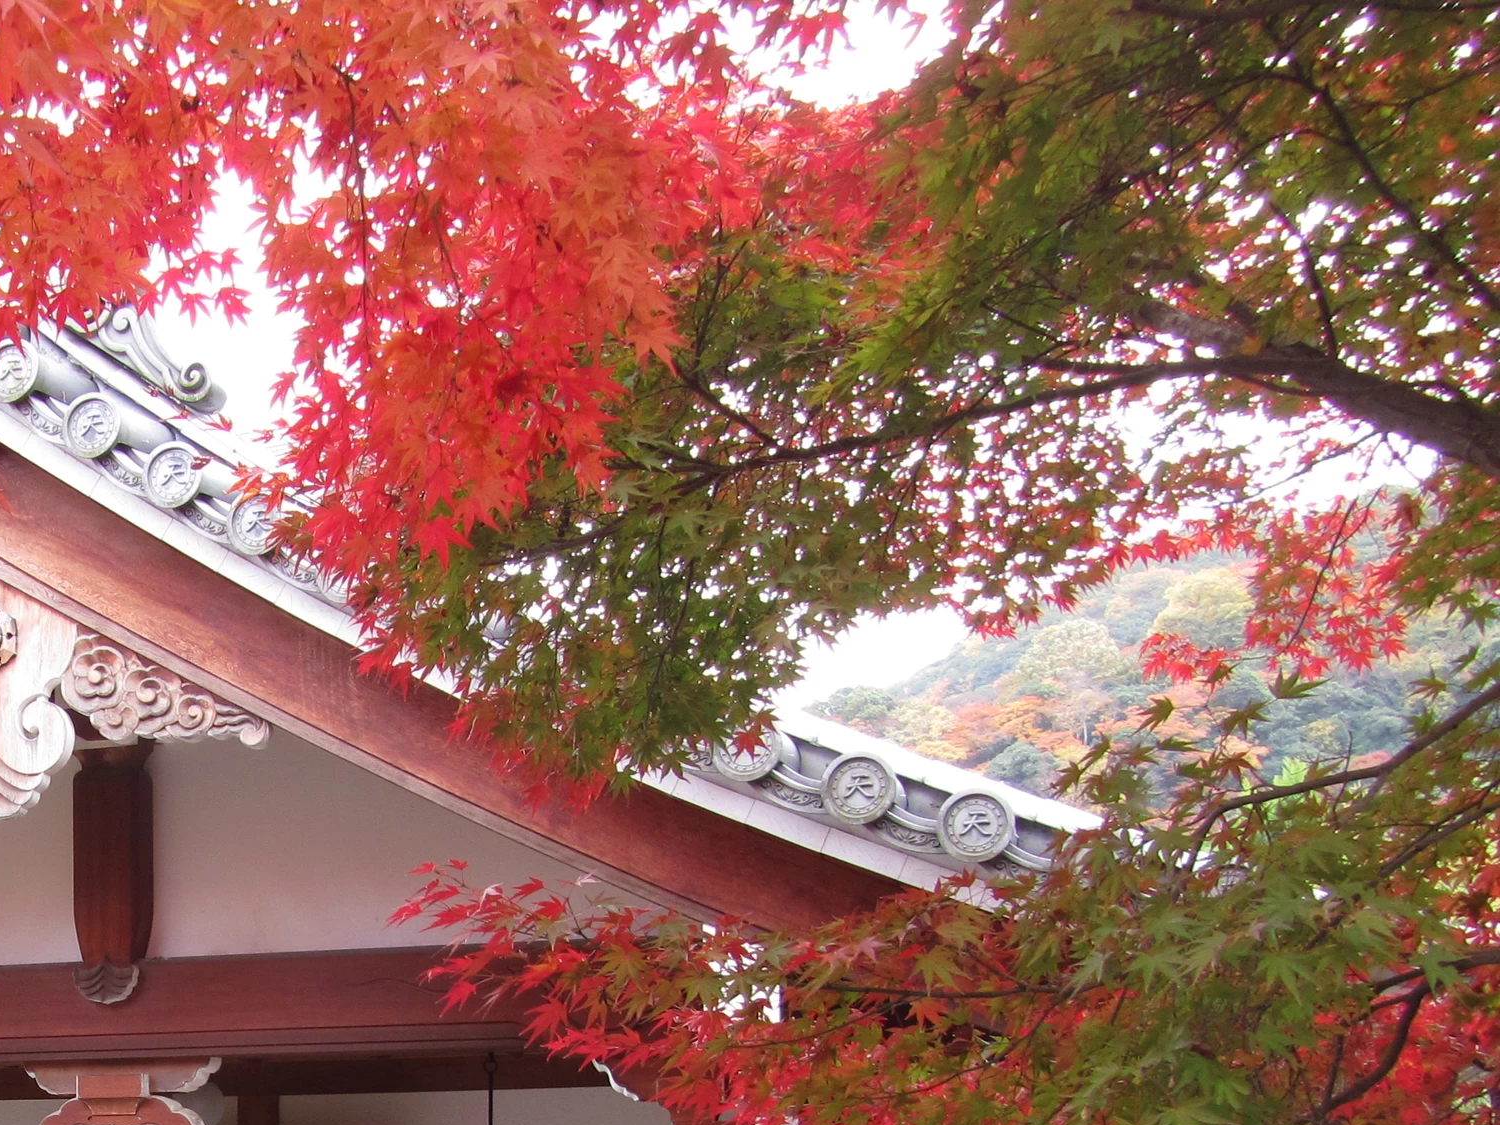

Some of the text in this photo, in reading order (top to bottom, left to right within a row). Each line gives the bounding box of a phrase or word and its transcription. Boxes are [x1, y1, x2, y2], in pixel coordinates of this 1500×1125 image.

[81, 413, 106, 438] 天
[160, 462, 186, 488] 天
[844, 774, 876, 800] 天
[958, 810, 993, 837] 天
